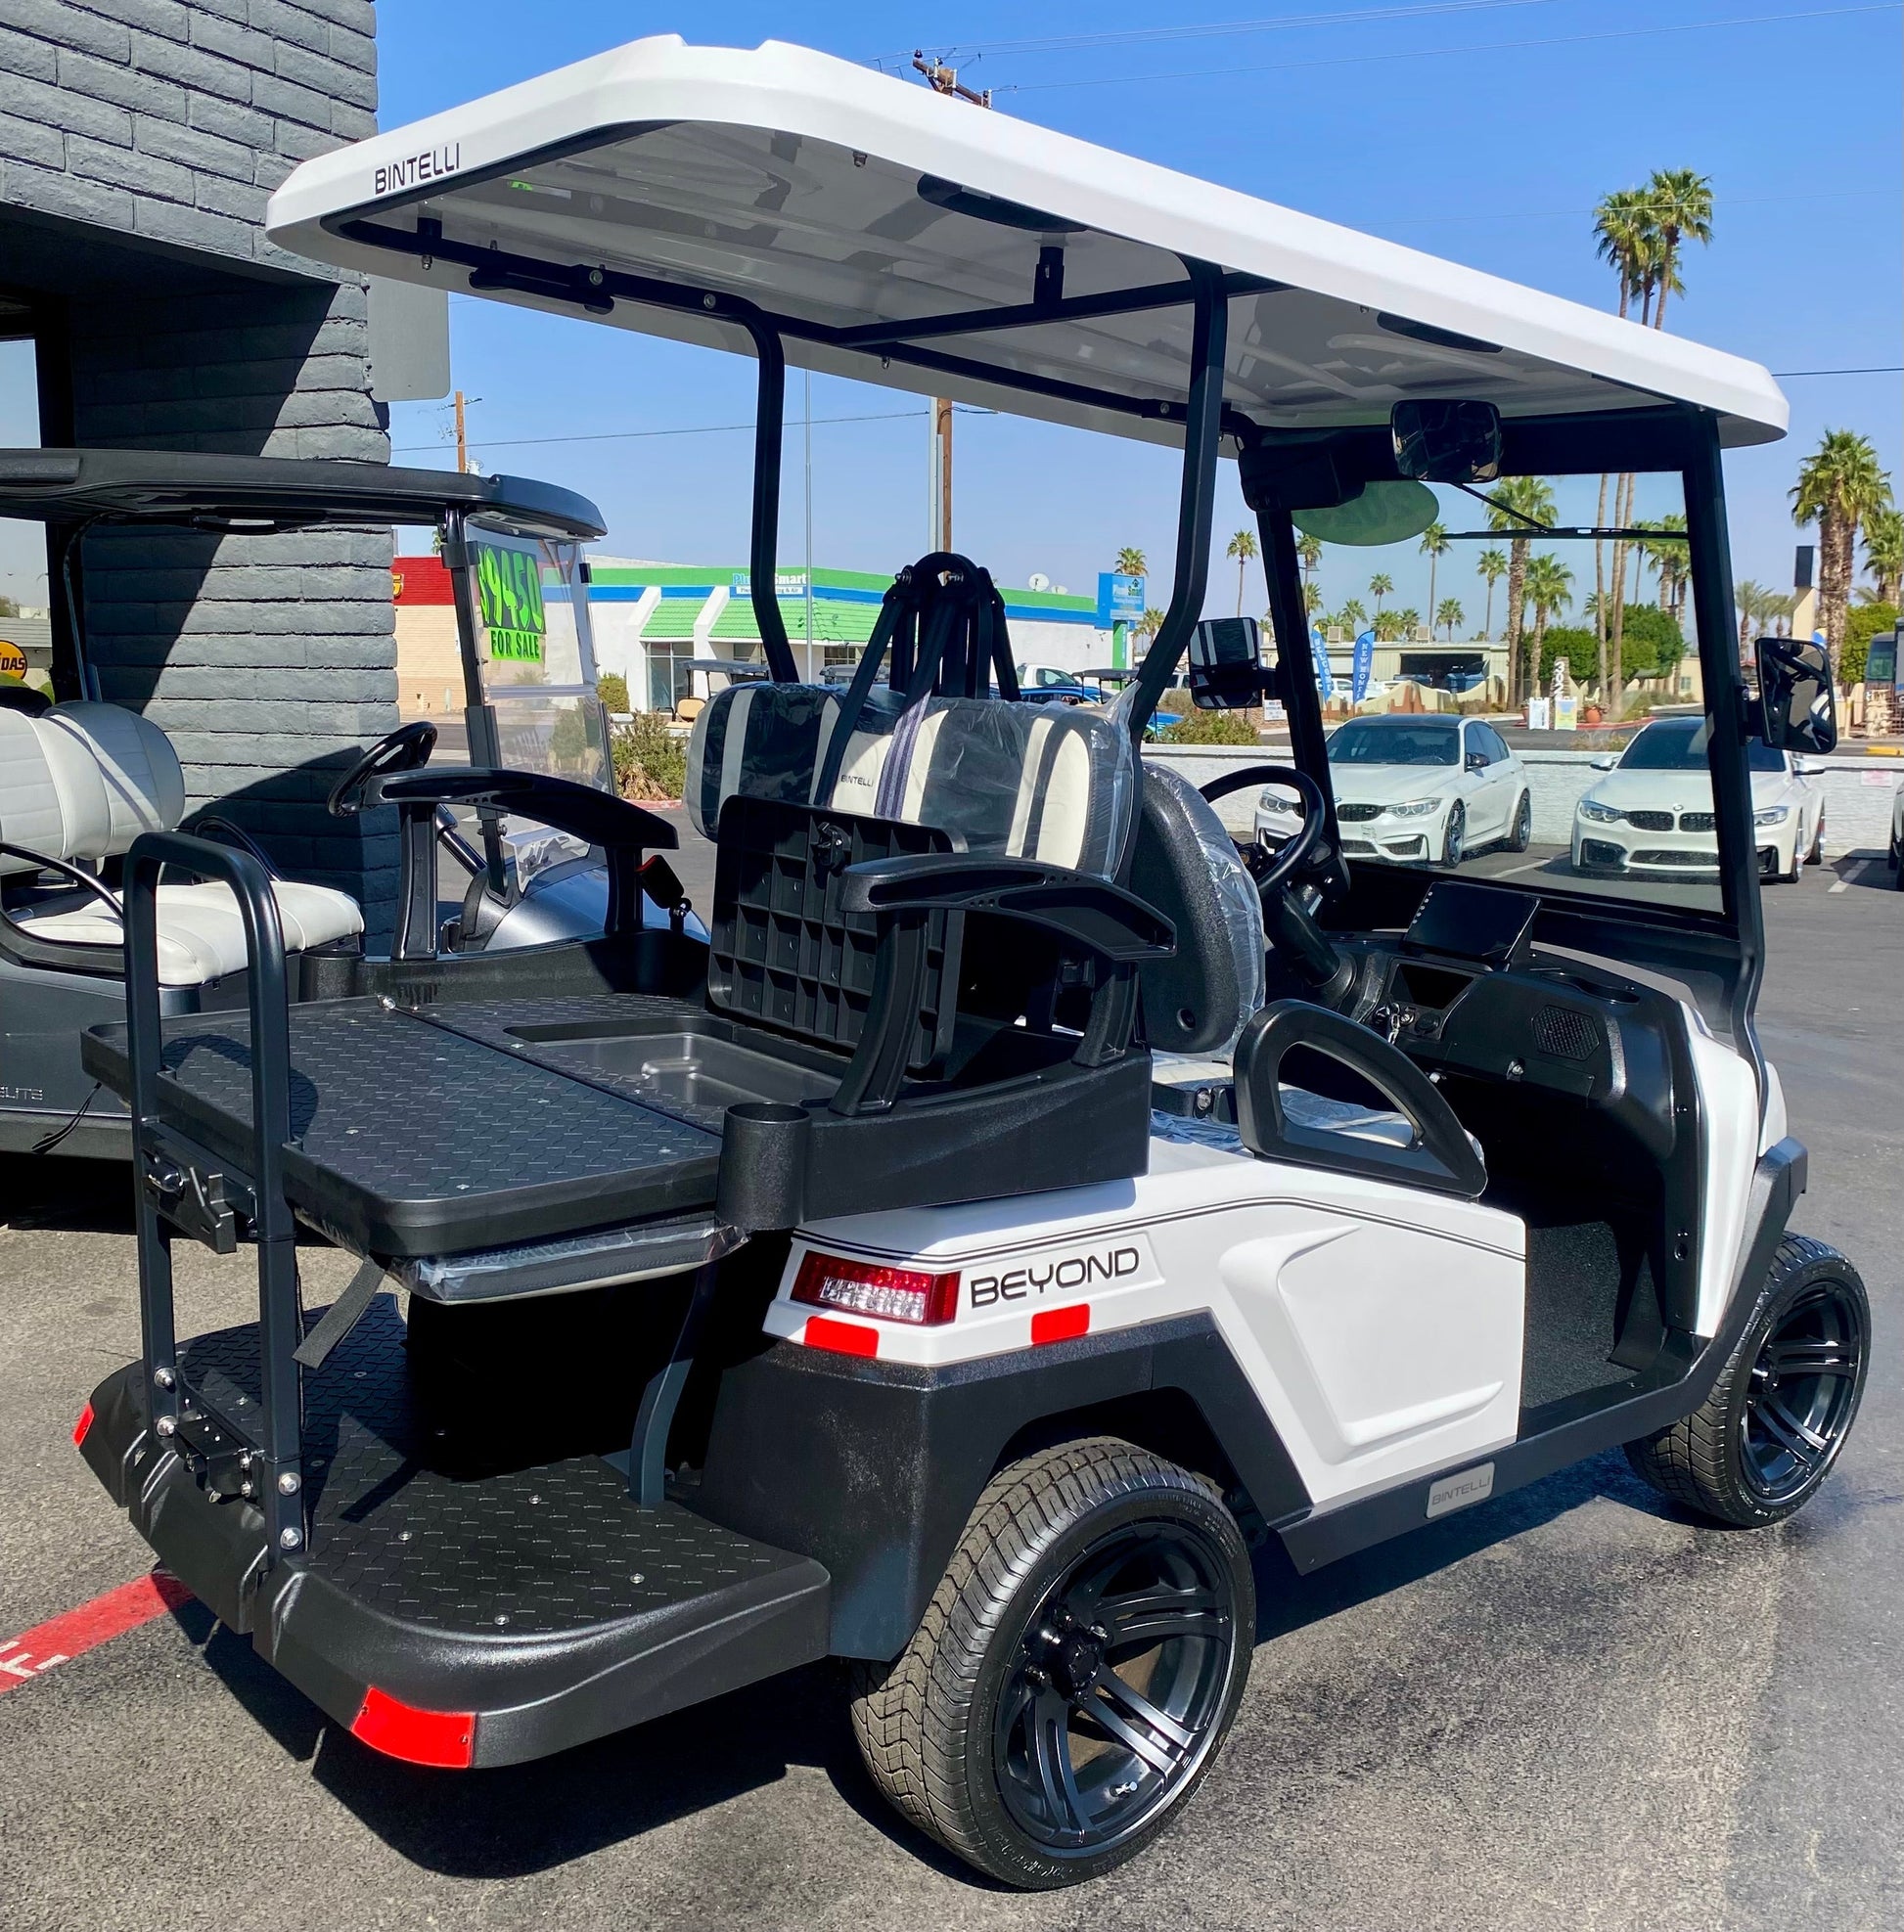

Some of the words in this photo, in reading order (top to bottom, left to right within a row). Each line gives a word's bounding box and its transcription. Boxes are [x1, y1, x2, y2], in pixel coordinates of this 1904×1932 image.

[375, 142, 460, 195] BINTELLI
[732, 573, 807, 585] PluSmart
[490, 630, 513, 657] FOR
[516, 633, 540, 659] SALE
[1359, 643, 1369, 664] NEW
[0, 656, 25, 671] DAS
[1314, 638, 1332, 692] WELCOME
[970, 1247, 1140, 1309] BEYOND
[1431, 1474, 1491, 1505] BINTELLI
